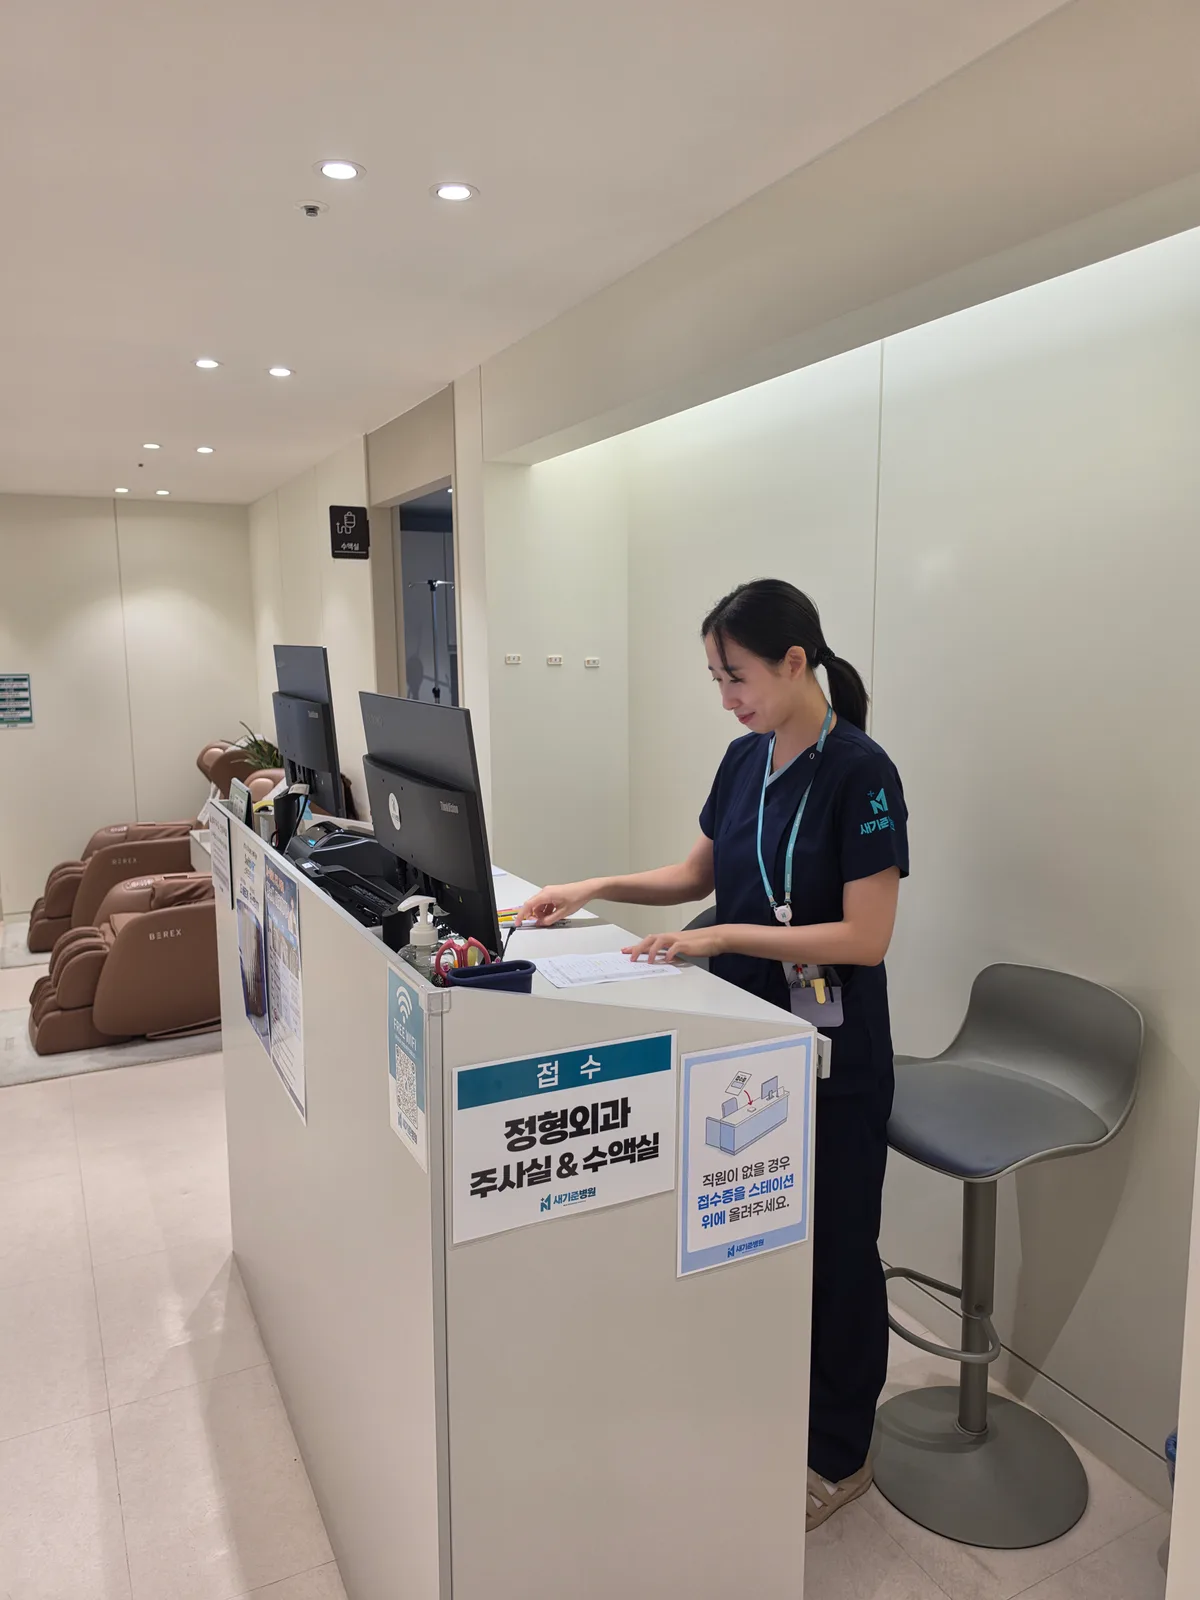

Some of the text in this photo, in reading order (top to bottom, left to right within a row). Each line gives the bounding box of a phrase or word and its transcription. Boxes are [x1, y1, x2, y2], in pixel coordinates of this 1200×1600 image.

[149, 929, 182, 940] BEREX
[504, 1097, 631, 1152] 정형외과
[470, 1132, 659, 1198] 주사실 & 수액실
[703, 1156, 790, 1187] 직원이 없을 경우
[553, 1187, 596, 1204] 새기준병원
[698, 1174, 793, 1210] 접수증을 스테이션
[702, 1196, 789, 1229] 위에 올려주세요.
